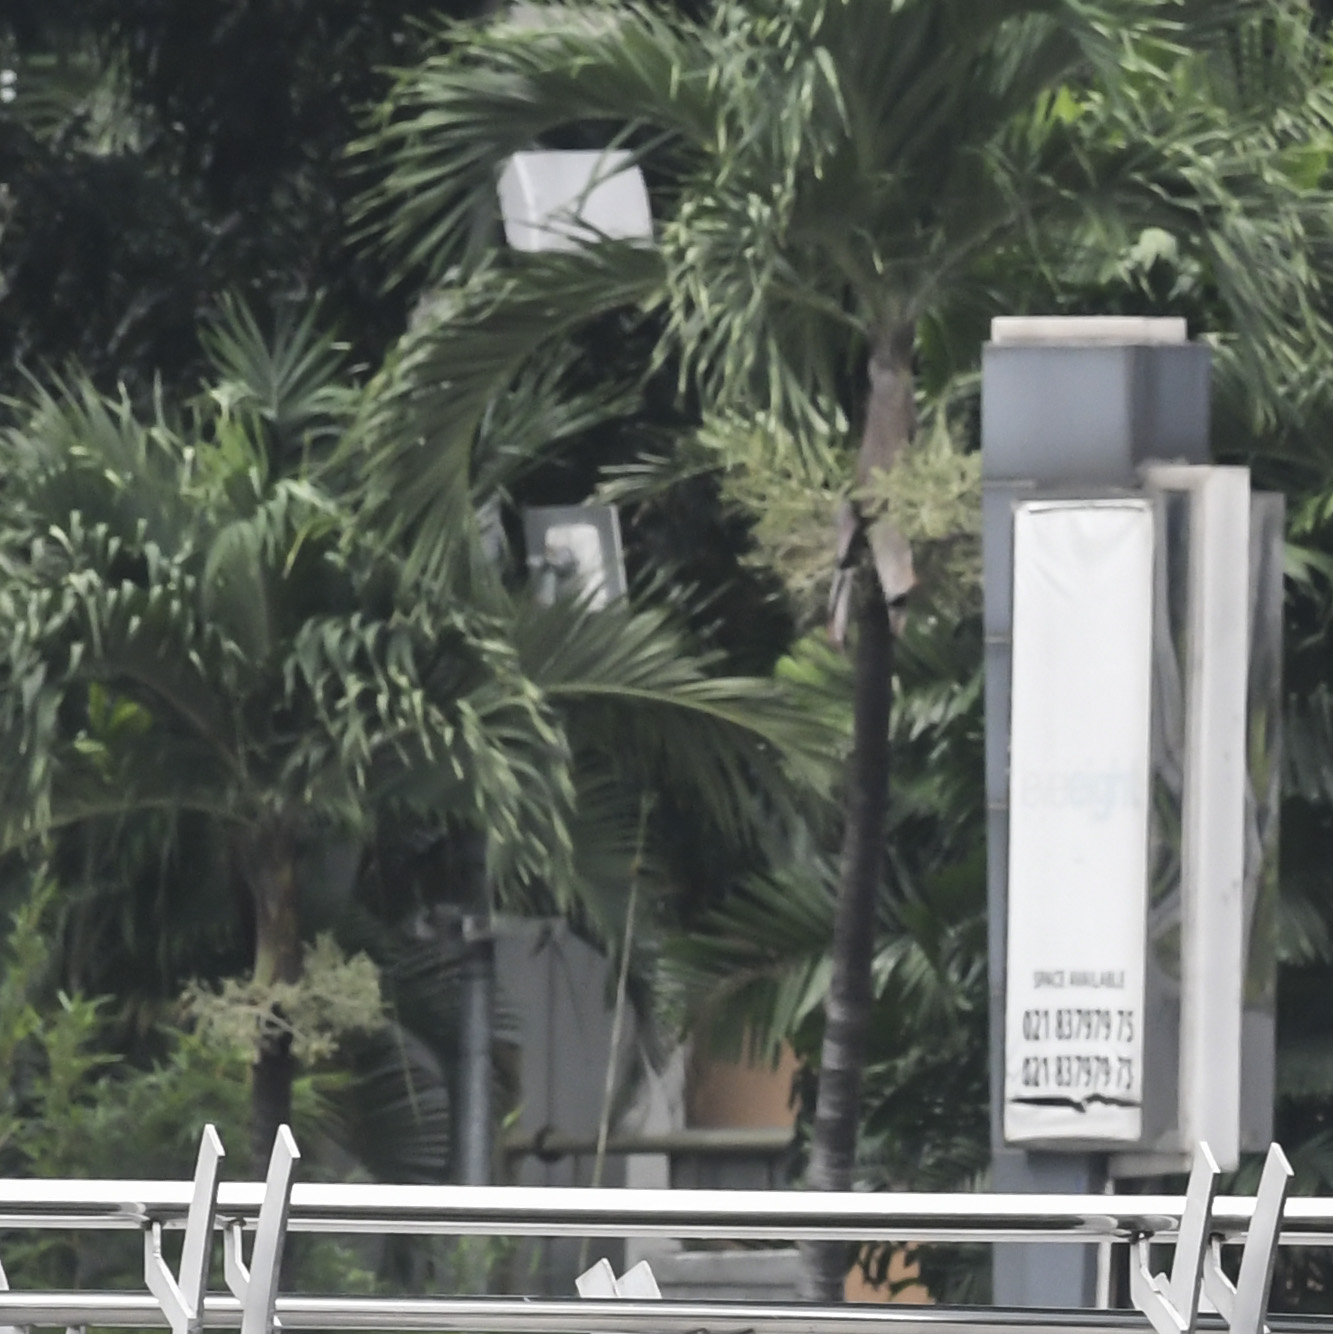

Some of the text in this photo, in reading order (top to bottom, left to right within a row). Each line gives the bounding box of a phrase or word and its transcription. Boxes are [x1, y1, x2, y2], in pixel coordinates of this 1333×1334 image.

[1033, 969, 1125, 989] SPACE AVAILABLE
[1022, 1009, 1049, 1041] 021
[1055, 1009, 1111, 1041] 837979
[1022, 1056, 1049, 1088] 021
